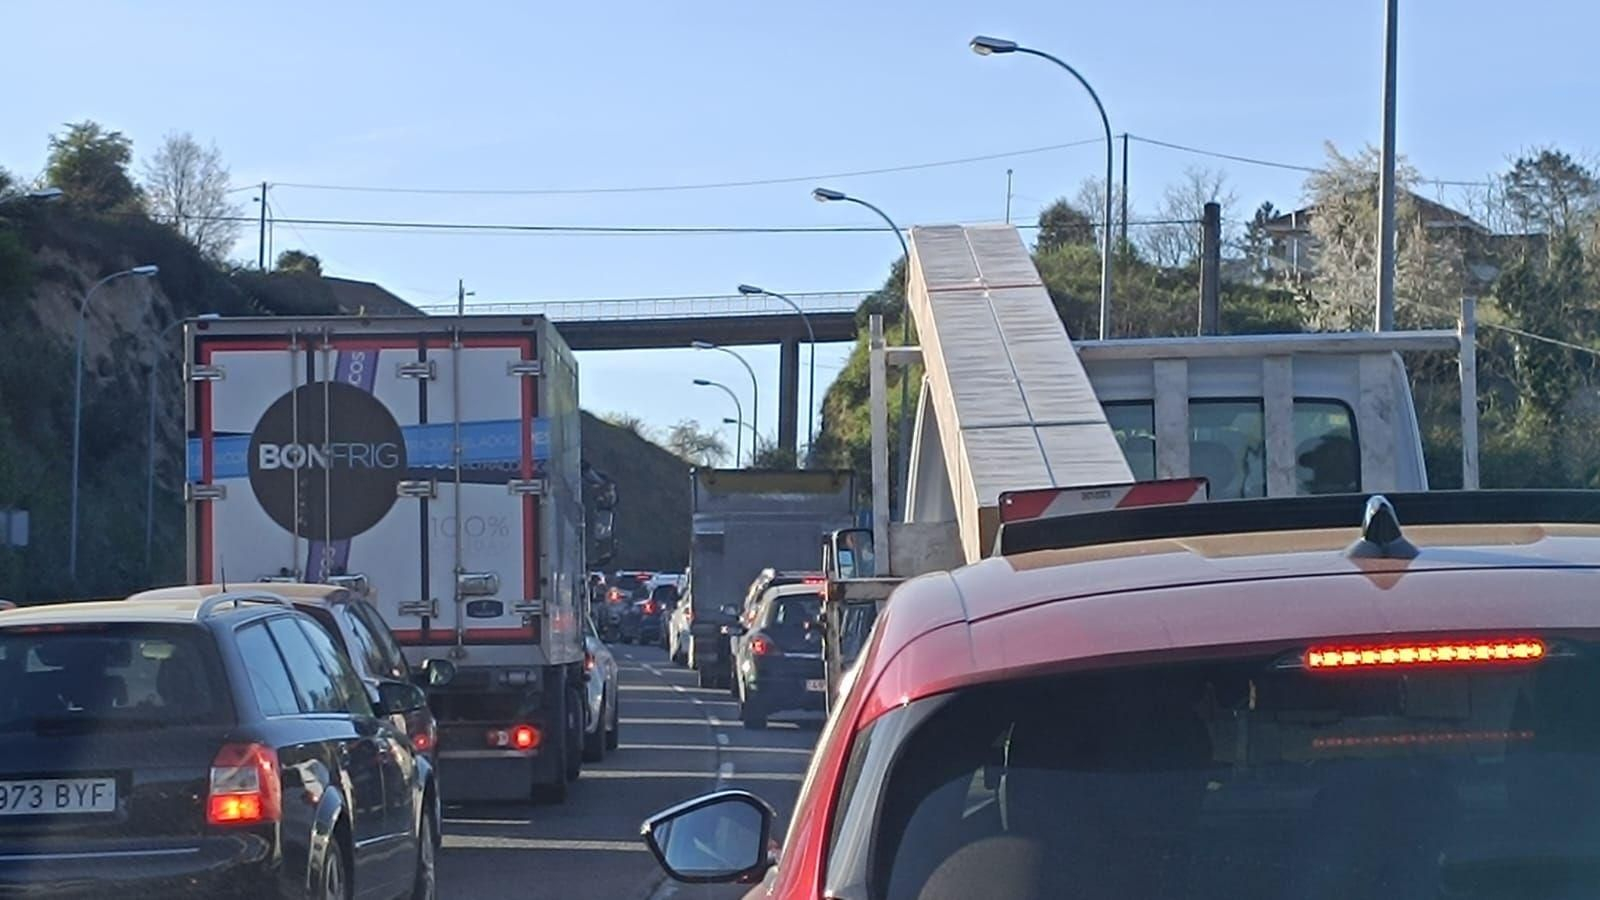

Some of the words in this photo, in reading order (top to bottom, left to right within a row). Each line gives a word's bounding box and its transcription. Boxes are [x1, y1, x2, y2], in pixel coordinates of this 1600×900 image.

[258, 442, 399, 470] BONFRIG
[431, 515, 510, 538] 100%
[56, 783, 107, 808] BYF
